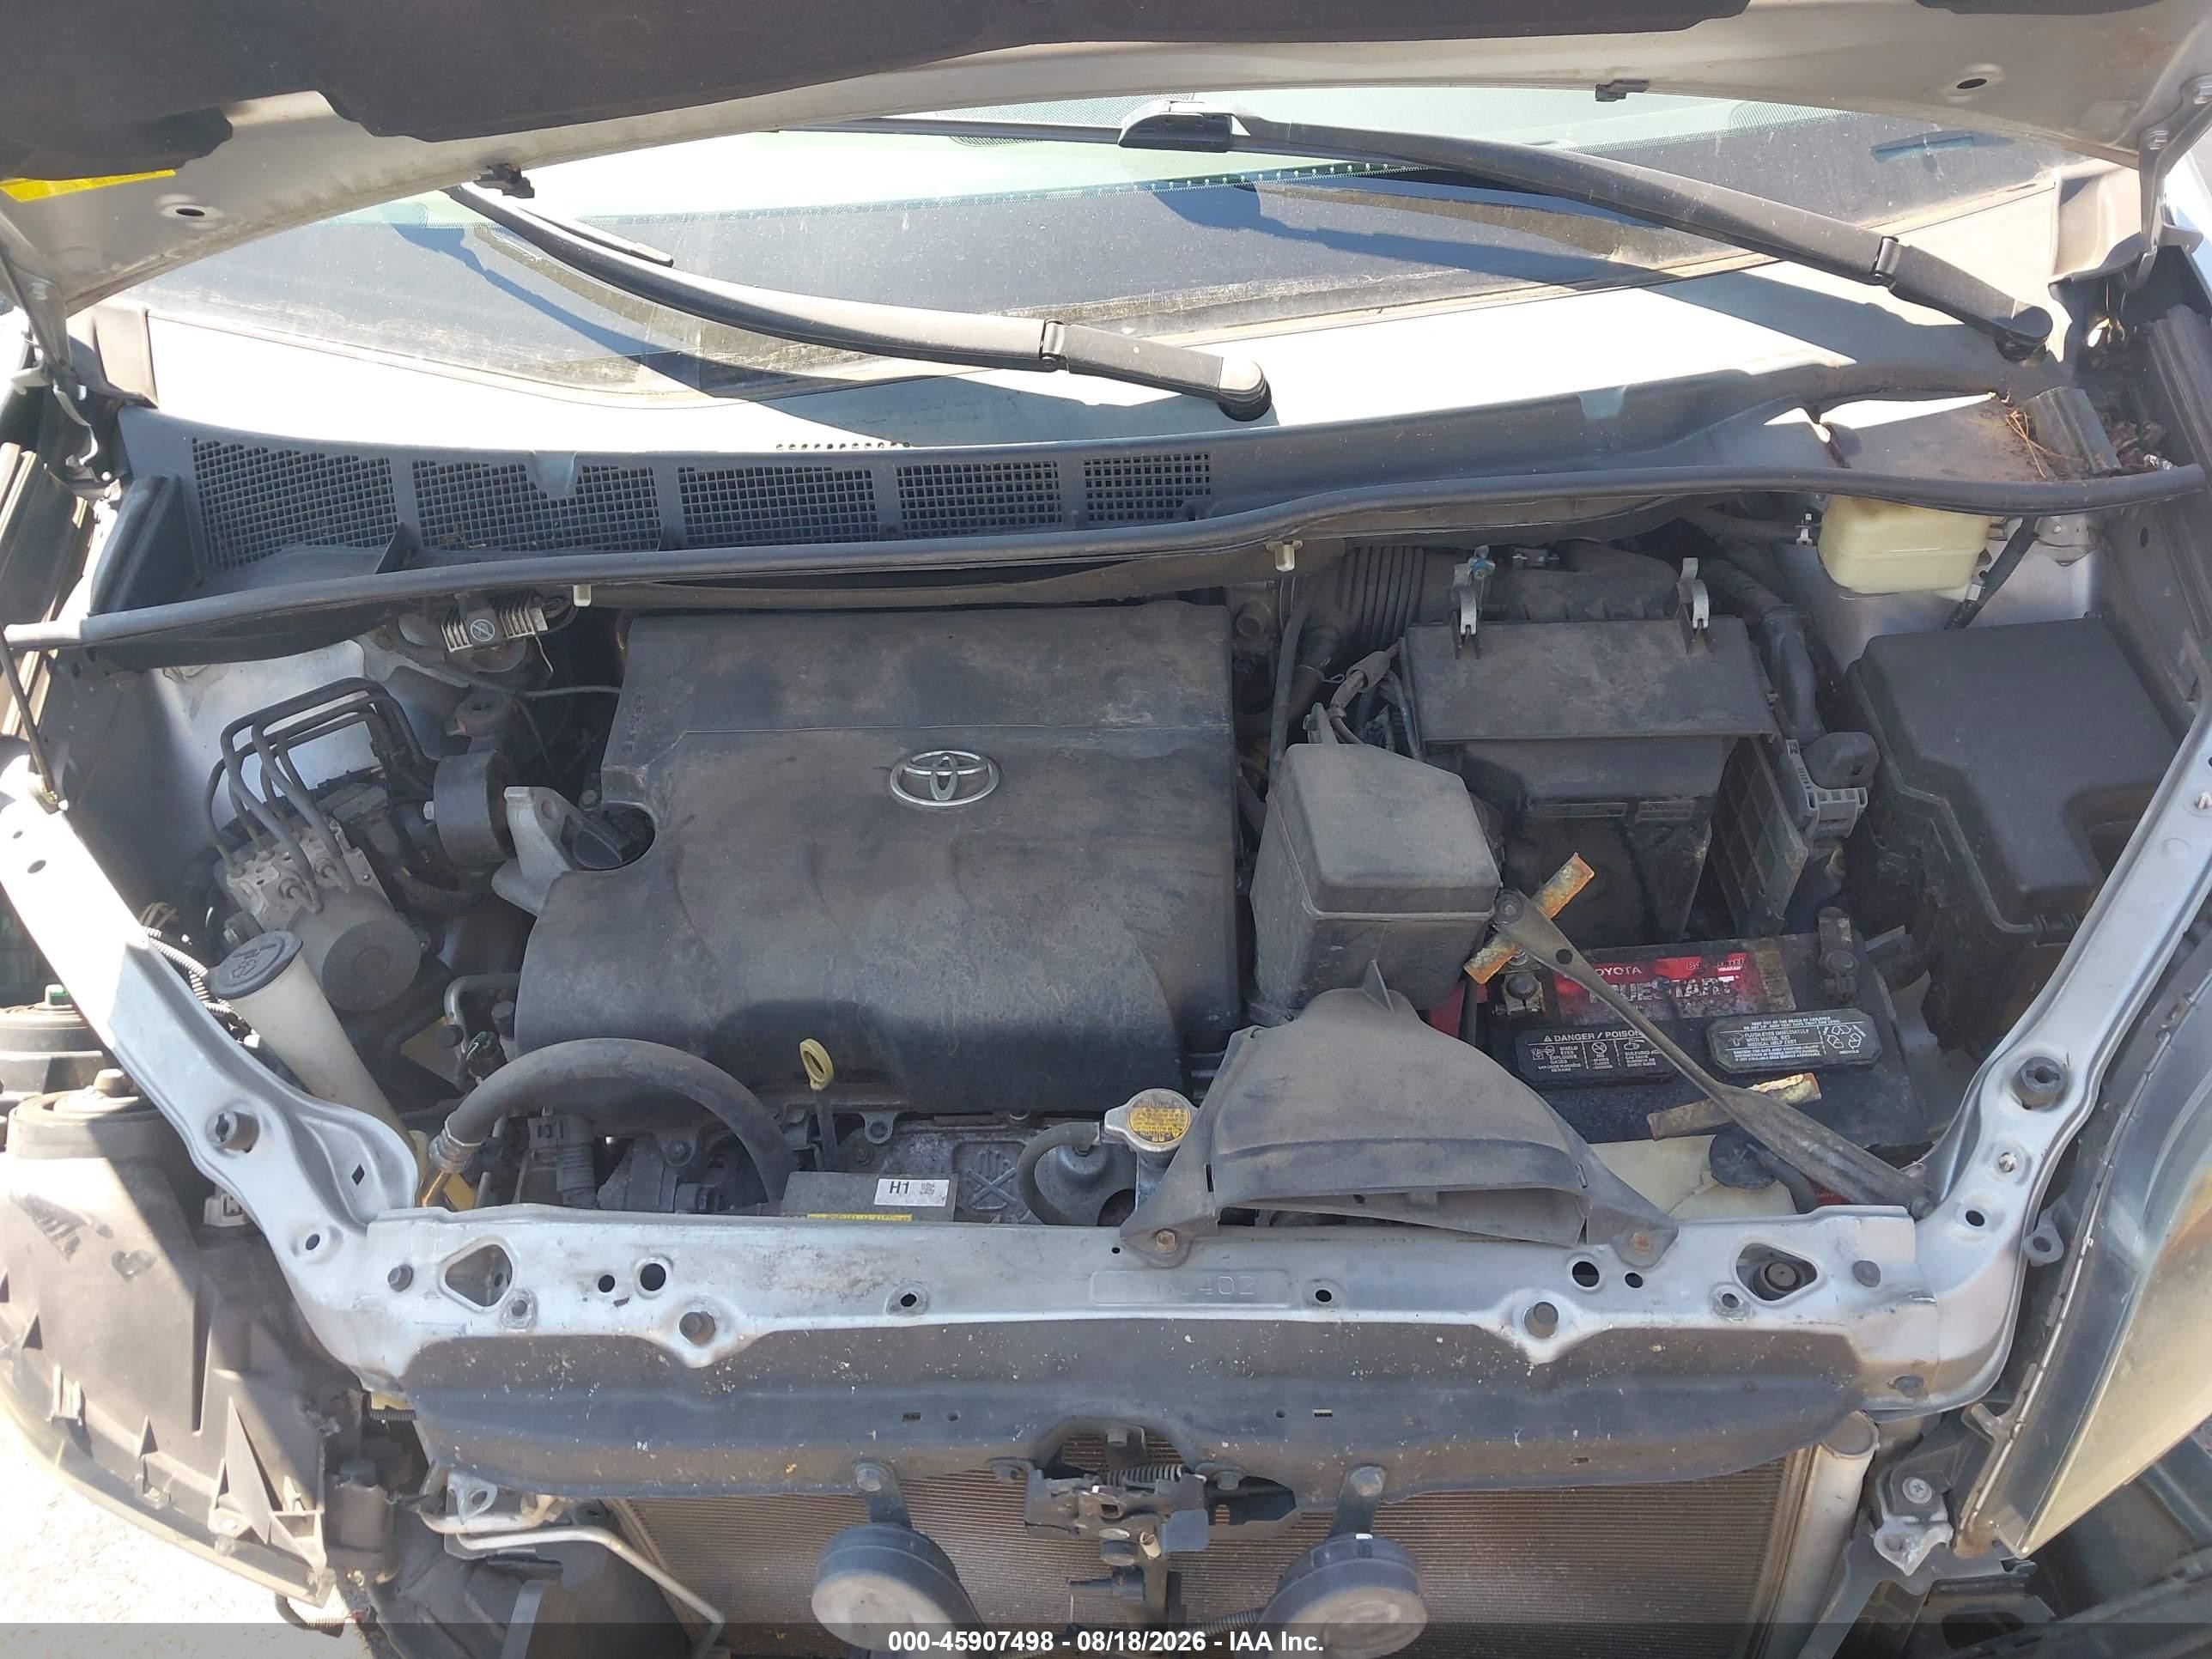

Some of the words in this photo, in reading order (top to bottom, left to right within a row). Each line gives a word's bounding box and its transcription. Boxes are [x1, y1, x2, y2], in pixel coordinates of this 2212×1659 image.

[1595, 966, 1642, 976] OYOTA
[1553, 1033, 1595, 1042] DANGER
[1597, 1031, 1603, 1040] /
[1605, 1030, 1642, 1038] POISON
[889, 1180, 910, 1194] H1
